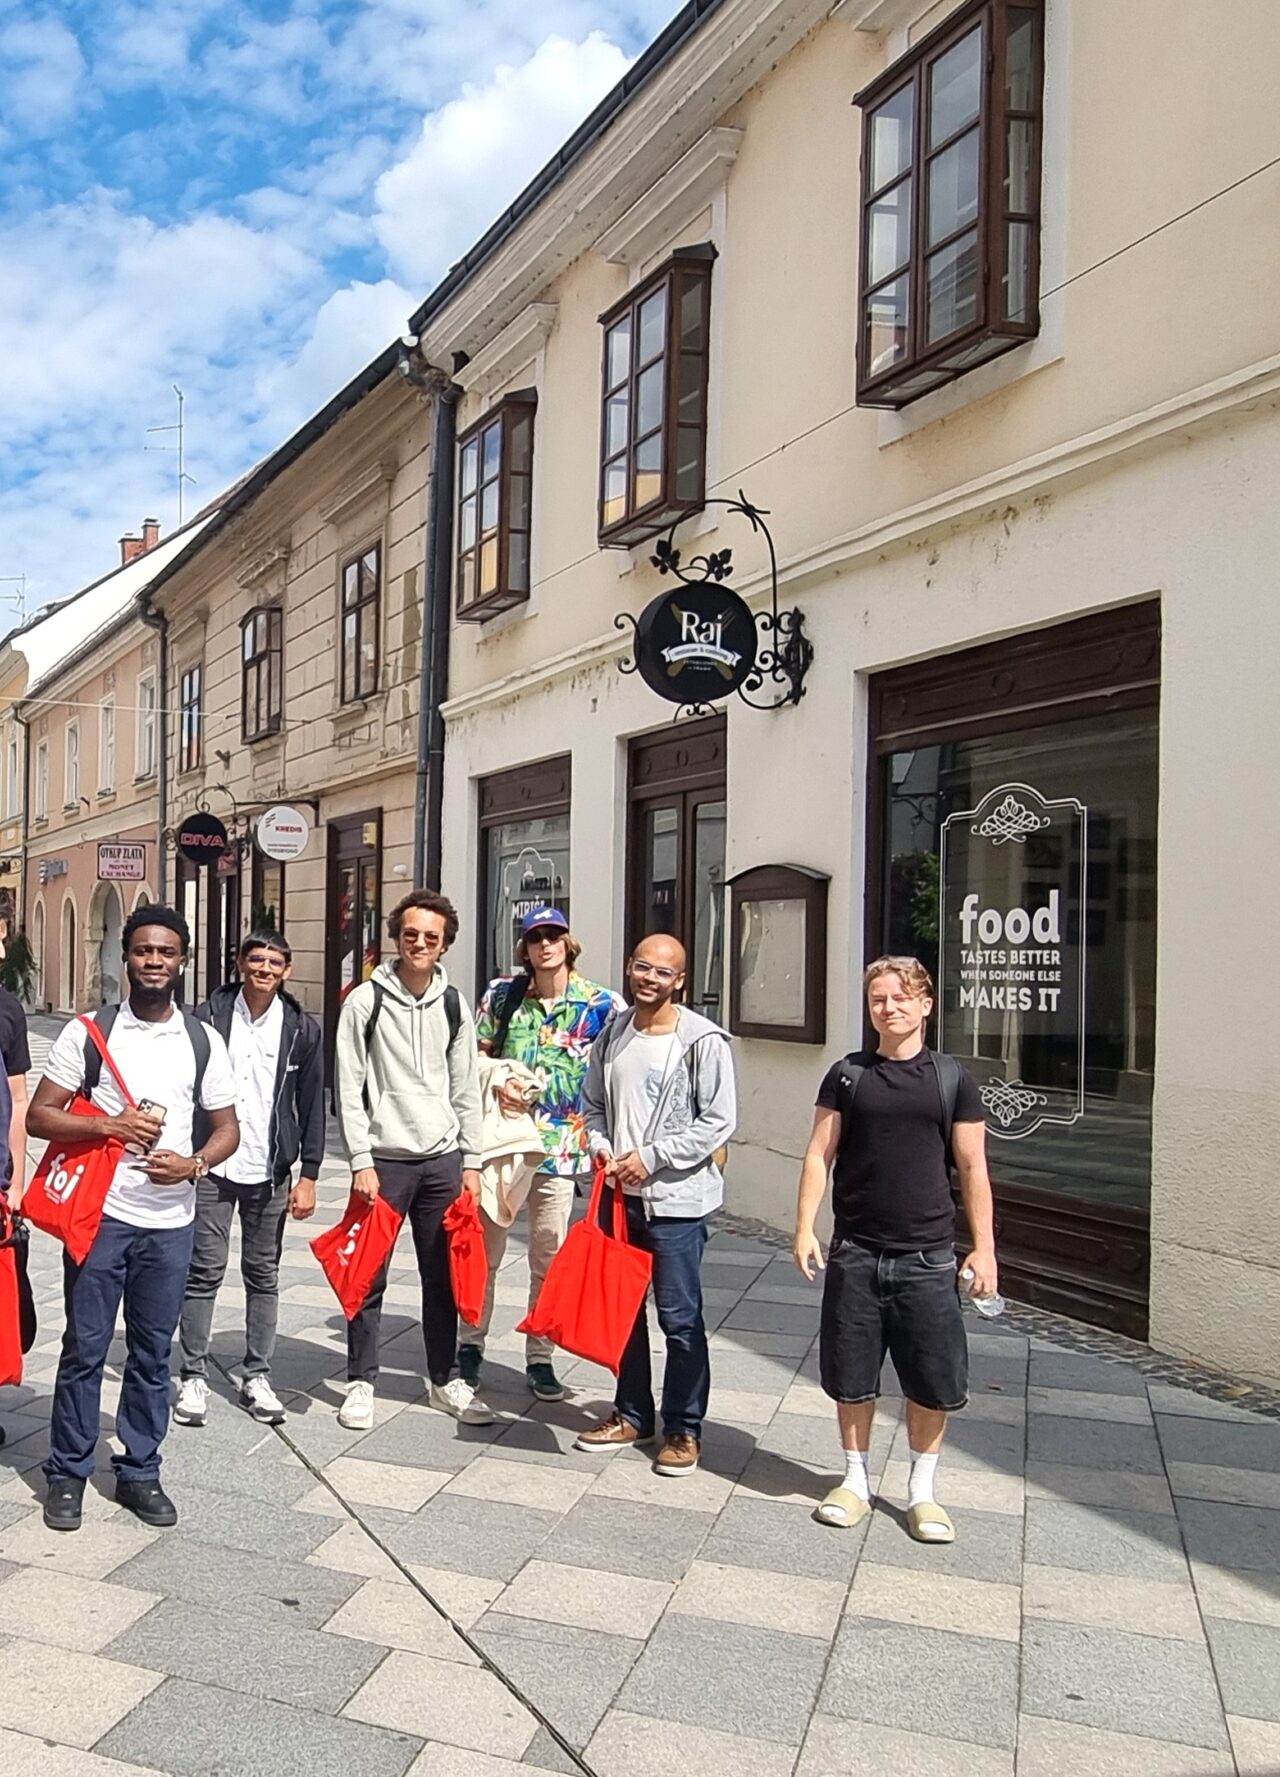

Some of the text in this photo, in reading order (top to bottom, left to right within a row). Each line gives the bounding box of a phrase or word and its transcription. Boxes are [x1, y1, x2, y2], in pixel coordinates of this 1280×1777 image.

[681, 611, 722, 650] Raj
[180, 832, 225, 847] DIVA
[959, 889, 1061, 945] food
[960, 949, 1061, 966] TASTES BETTER
[960, 969, 1062, 982] WHEN SOMEONE ELSE
[960, 985, 1061, 1013] MAKES IT
[44, 1152, 85, 1204] foi
